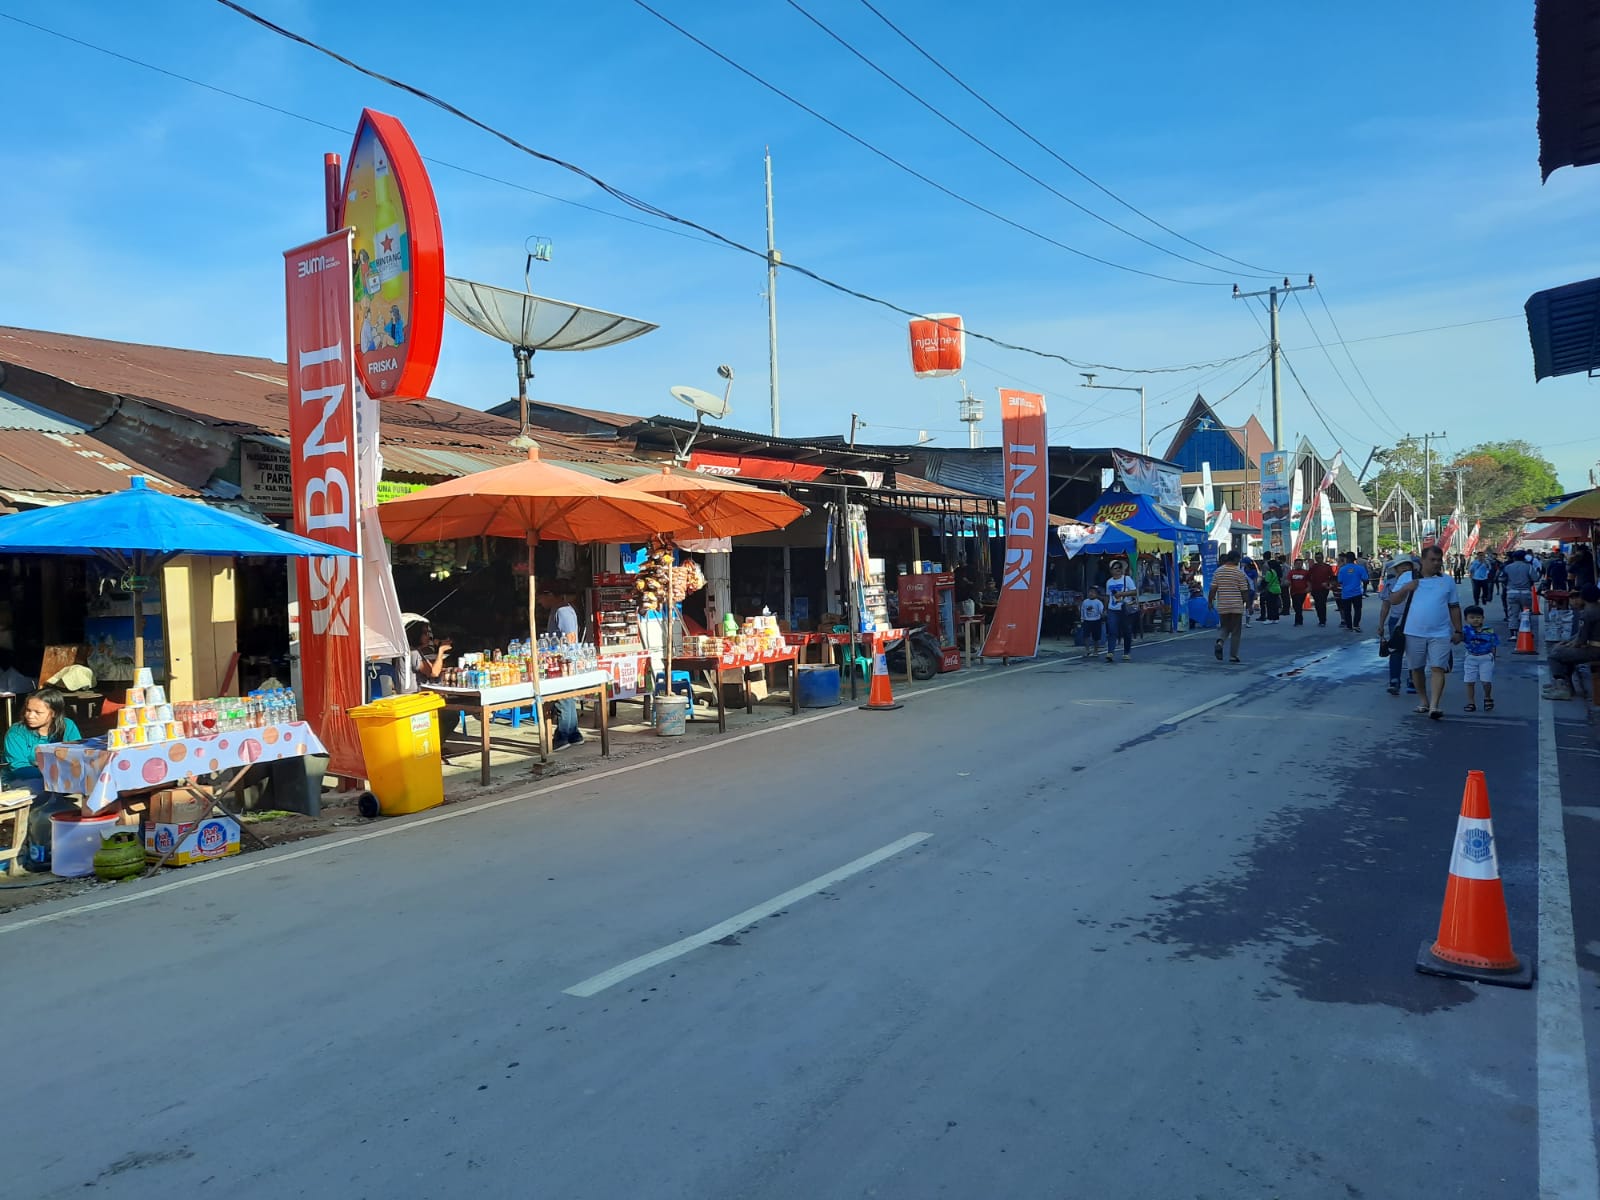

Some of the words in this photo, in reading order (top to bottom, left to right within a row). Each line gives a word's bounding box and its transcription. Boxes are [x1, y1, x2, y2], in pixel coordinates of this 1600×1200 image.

[368, 357, 398, 374] FRISKA
[299, 340, 350, 534] BNI
[1098, 502, 1137, 516] Hydro
[1094, 512, 1130, 524] Coco
